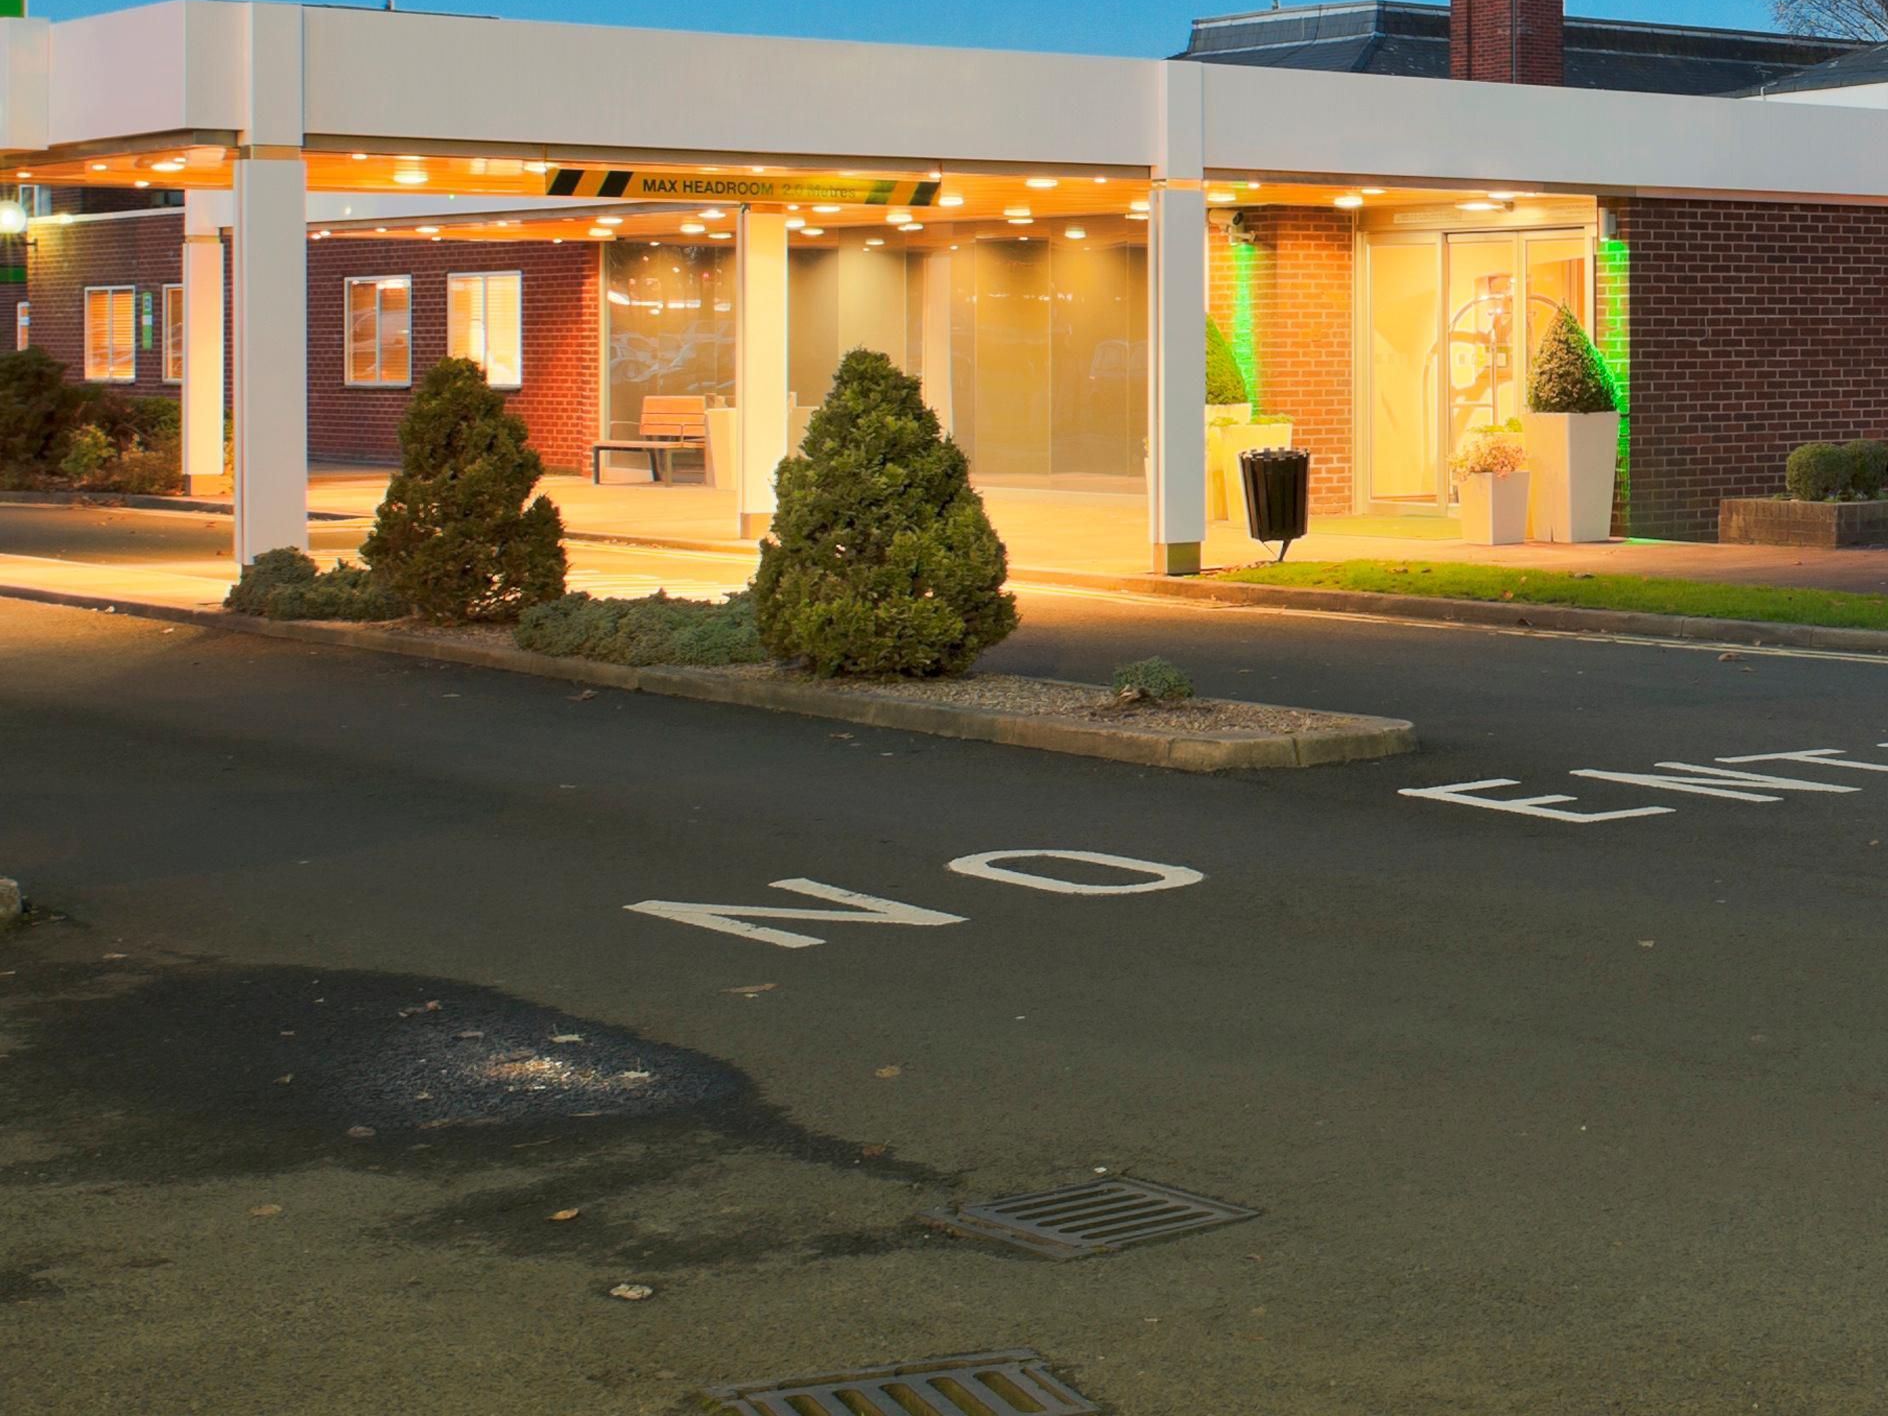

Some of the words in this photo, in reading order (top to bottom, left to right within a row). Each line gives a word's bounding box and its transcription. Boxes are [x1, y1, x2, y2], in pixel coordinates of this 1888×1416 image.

[643, 178, 678, 193] MAX
[683, 180, 773, 196] HEADROOM
[623, 849, 1204, 949] NO
